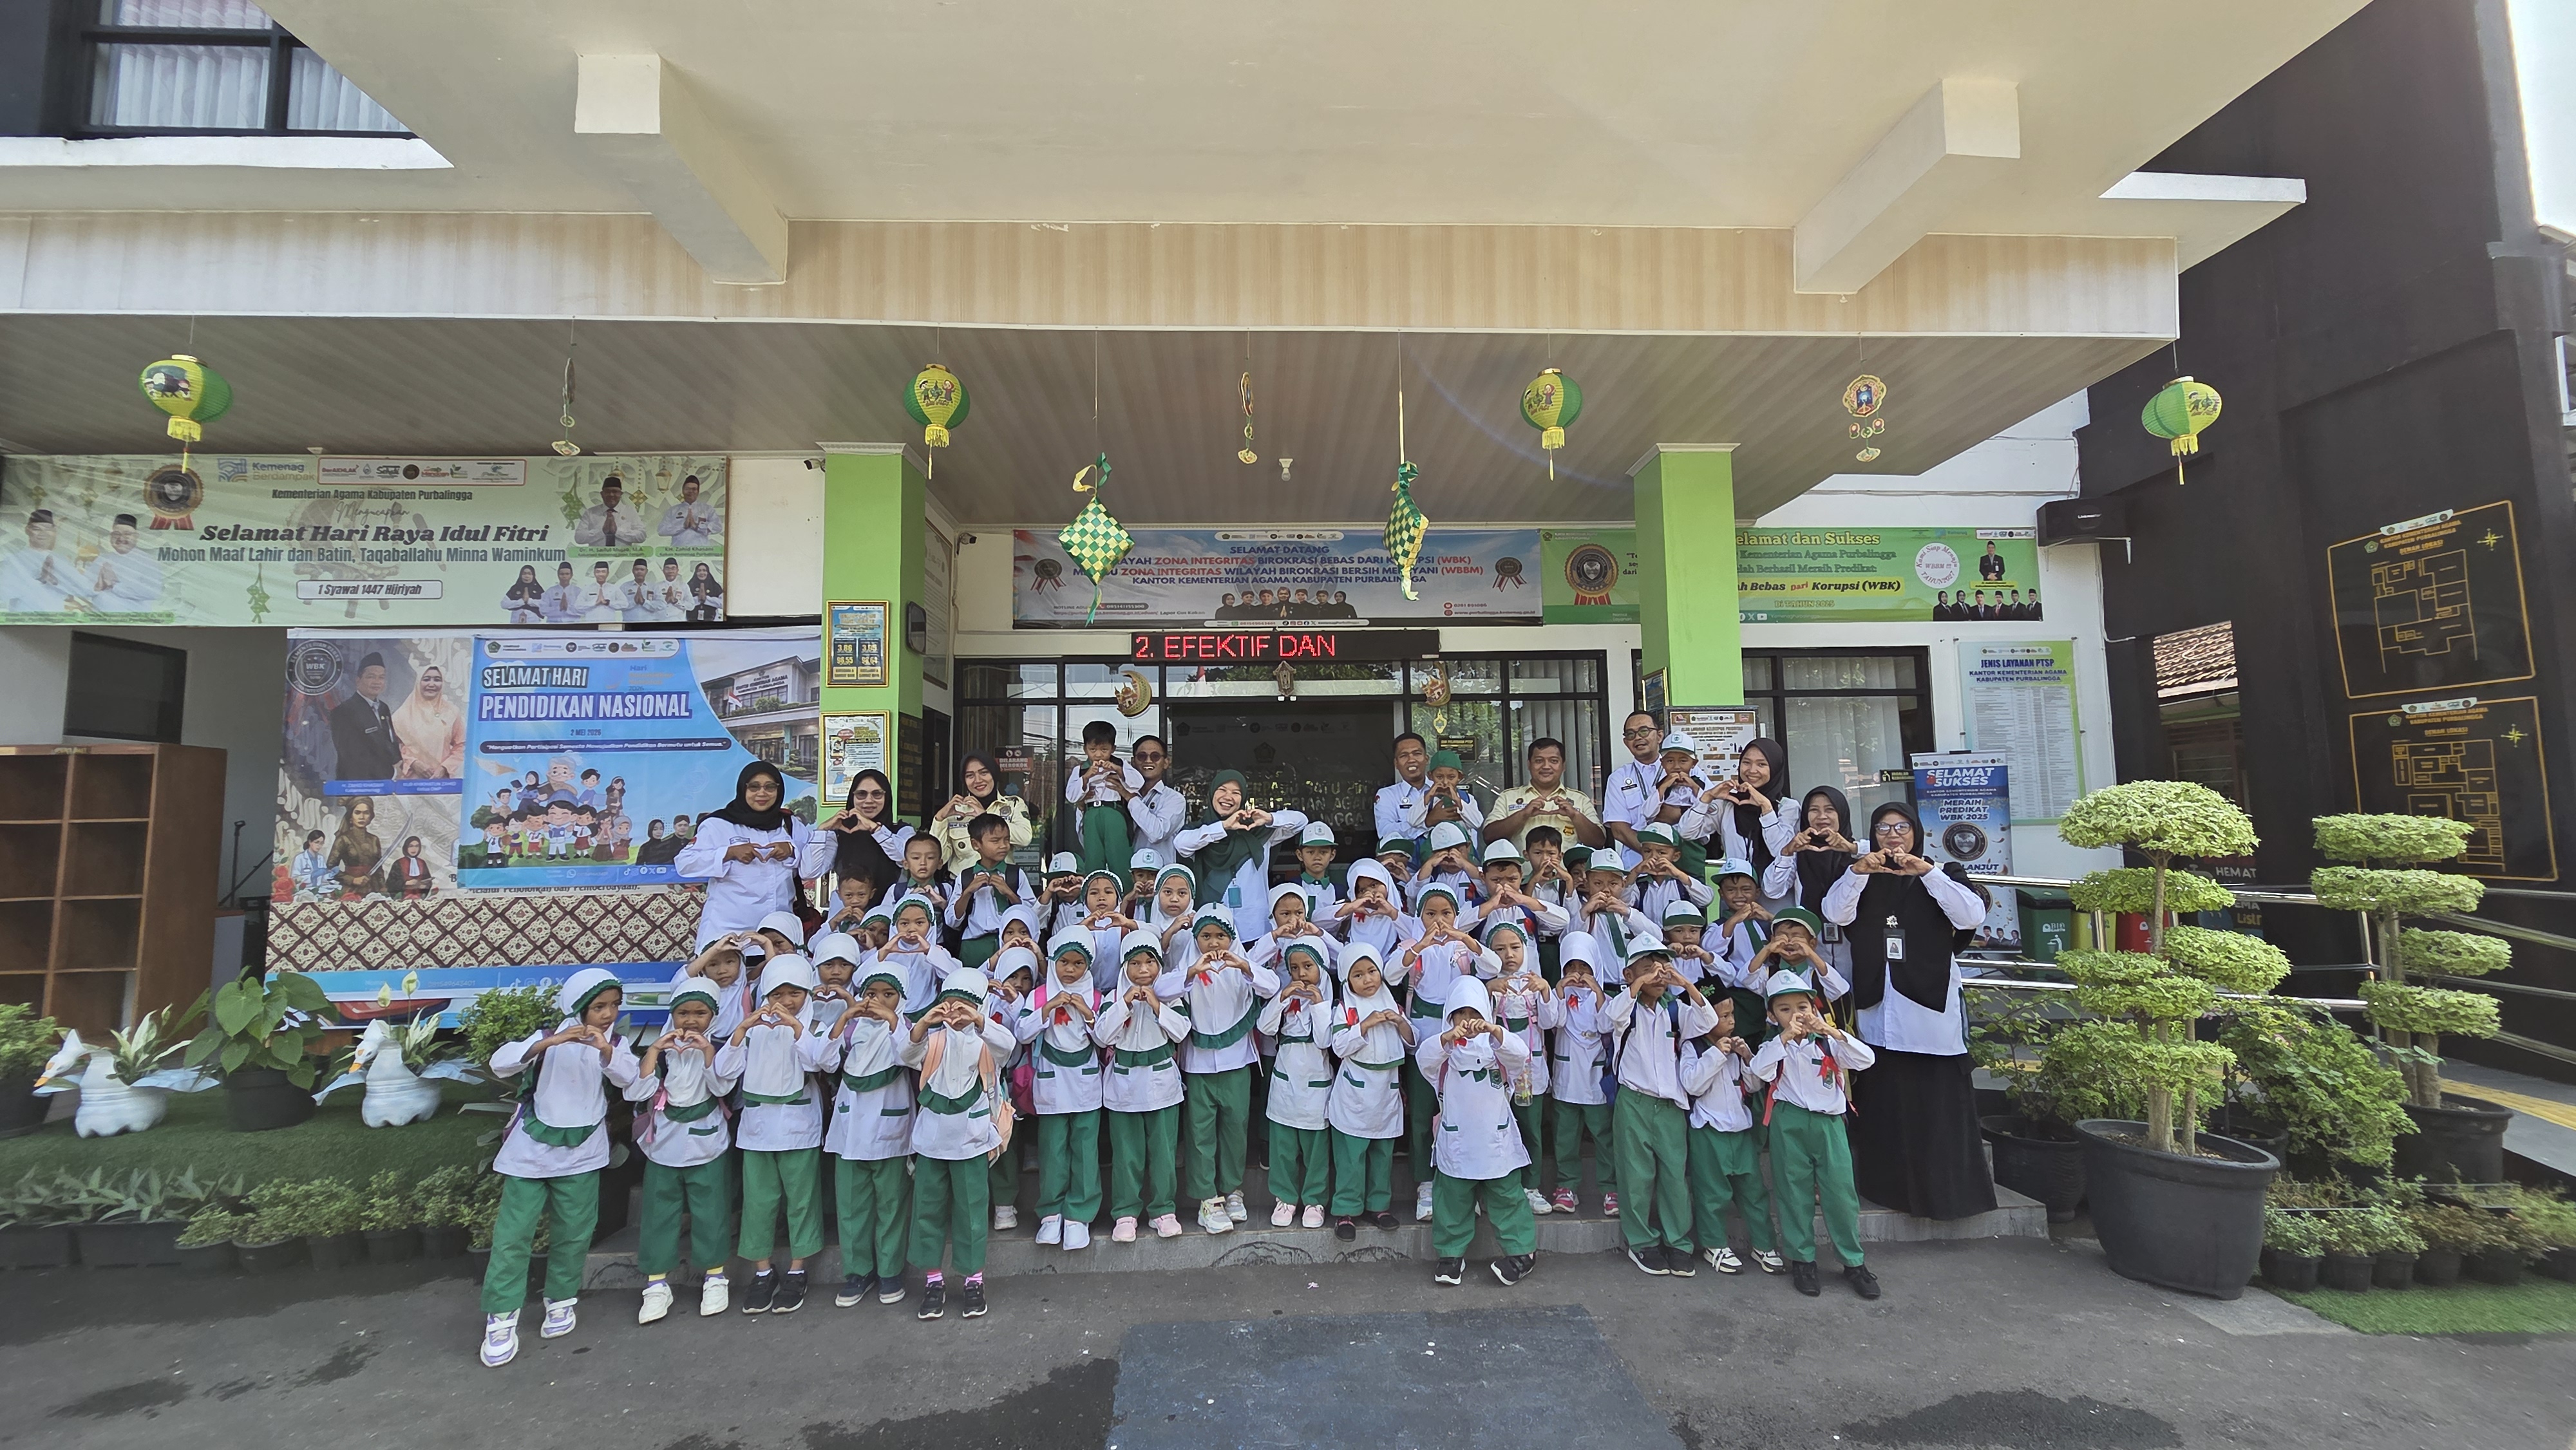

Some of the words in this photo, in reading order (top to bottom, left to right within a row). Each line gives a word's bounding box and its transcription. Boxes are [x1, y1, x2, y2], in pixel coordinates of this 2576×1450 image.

[252, 462, 305, 472] Kemenag
[252, 472, 315, 482] Berdampak
[272, 489, 331, 499] Kementerian
[333, 489, 365, 500] Agama
[367, 490, 416, 501] Kabupaten
[419, 490, 473, 501] Purbalingga
[200, 525, 305, 542] Selamat
[311, 525, 369, 542] Hari
[374, 525, 434, 546] Raya
[440, 525, 489, 542] Idul
[495, 525, 550, 542] Fitri
[1736, 532, 1788, 545] elamat
[1792, 531, 1822, 545] dan
[1824, 532, 1880, 545] Sukses
[158, 547, 206, 562] Mohon
[209, 547, 245, 562] Maaf
[249, 547, 284, 562] Lahir
[287, 547, 313, 562] dan
[317, 547, 356, 563] Batin,
[359, 547, 442, 563] Taqaballahu
[446, 547, 487, 562] Minna
[491, 547, 566, 562] Waminkum
[1230, 546, 1280, 554] SELAMAT
[1740, 550, 1803, 558] Kementerian
[1804, 550, 1838, 560] Agama
[1839, 549, 1897, 560] Purbalingga
[1155, 557, 1188, 565] ZONA
[1191, 556, 1255, 565] INTEGRITAS
[1258, 556, 1318, 565] BIROKRASI
[1321, 556, 1355, 565] BEBAS
[1357, 556, 1385, 565] DARI
[1387, 556, 1435, 565] KPSI
[1437, 556, 1472, 565] (WBK)
[1121, 568, 1155, 576] ZONA
[1158, 568, 1222, 576] INTEGRITAS
[1224, 567, 1276, 576] WILAYAH
[1279, 567, 1339, 576] BIROKRASI
[1342, 567, 1380, 576] BERSIH
[1441, 567, 1484, 576] (WBBM)
[1737, 564, 1755, 573] lah
[1756, 564, 1797, 573] Berhasil
[1797, 563, 1833, 572] Meraih
[318, 585, 323, 595] 1
[325, 584, 359, 597] Syawal
[361, 585, 384, 595] 1447
[386, 584, 422, 597] Hijriyah
[1750, 581, 1786, 591] Bebas
[1790, 581, 1808, 591] Dari
[1812, 581, 1860, 592] Korupsi
[1862, 580, 1901, 592] (WBK)
[1136, 636, 1153, 658] 2.
[1164, 635, 1271, 658] EFEKTIF
[1280, 635, 1335, 657] DAN
[1980, 659, 2001, 668] JENIS
[2002, 659, 2034, 668] LAYANAN
[2036, 659, 2055, 667] PTSP
[484, 667, 550, 686] SELAMAT
[551, 667, 587, 686] HARI
[481, 694, 594, 719] PENDIDIKAN
[598, 693, 691, 718] NASIONAL
[1926, 767, 1995, 778] SELAMAT
[1934, 777, 1989, 787] SUKSES
[2215, 866, 2257, 878] HEMAT
